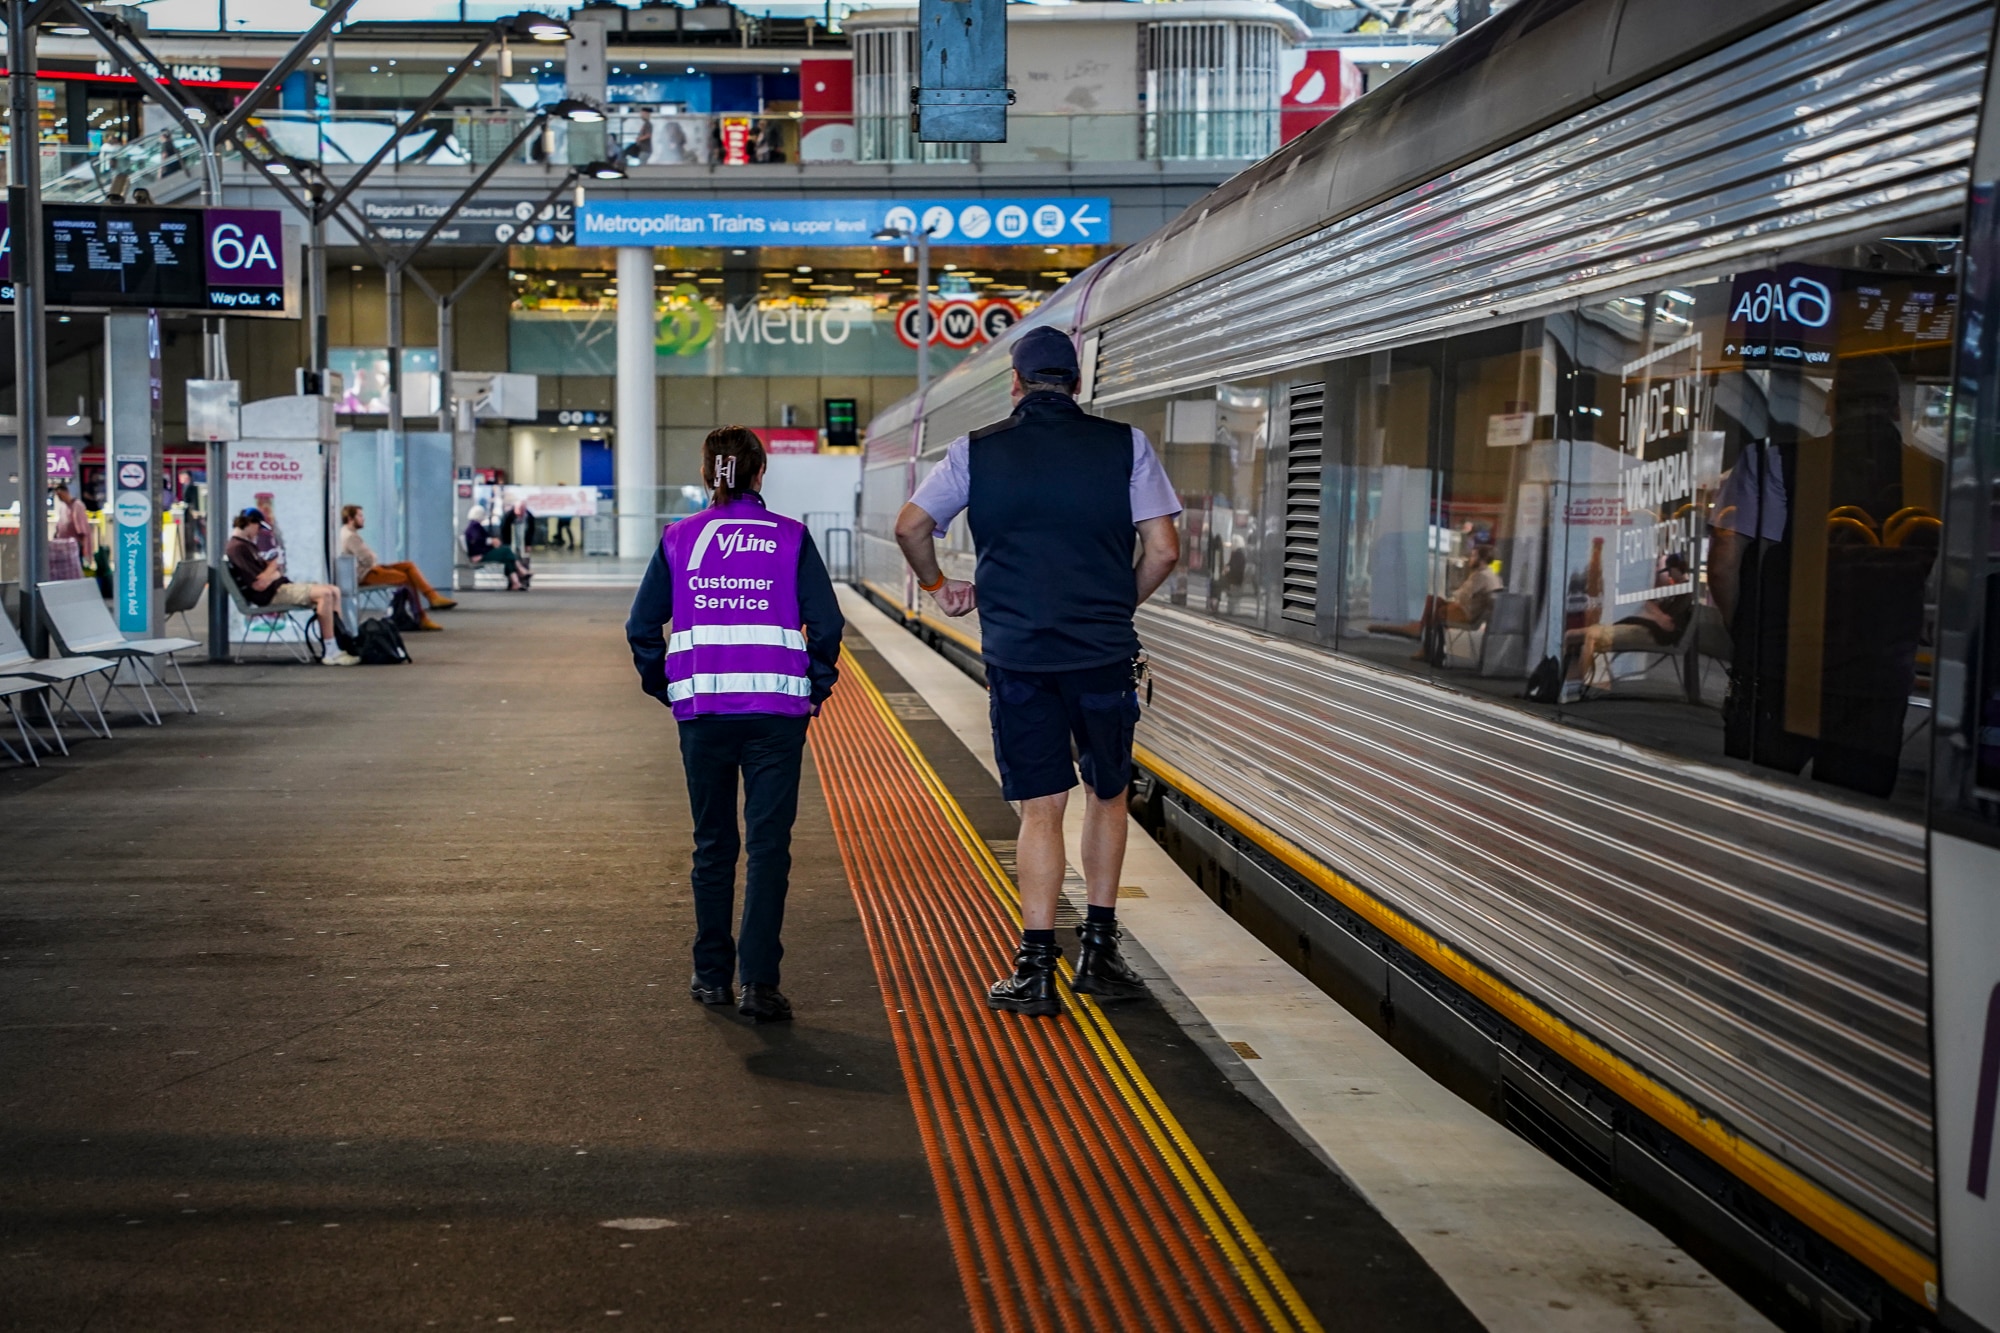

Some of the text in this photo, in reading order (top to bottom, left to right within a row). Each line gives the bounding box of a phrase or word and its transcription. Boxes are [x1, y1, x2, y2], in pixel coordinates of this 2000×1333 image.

[366, 204, 415, 218] Regional
[585, 213, 866, 236] Metropolitan Trains via upper level
[211, 223, 277, 270] 6A
[210, 292, 261, 306] Way Out
[724, 303, 850, 345] Metro
[1626, 375, 1691, 450] MADE IN
[237, 451, 260, 459] Next
[231, 461, 301, 472] ICE COLD
[1625, 452, 1690, 512] VICTORIA
[118, 503, 147, 512] Meeting
[716, 528, 777, 559] V/Line
[128, 549, 138, 616] Travellers Aid
[688, 575, 774, 590] Customer
[694, 595, 769, 610] Service
